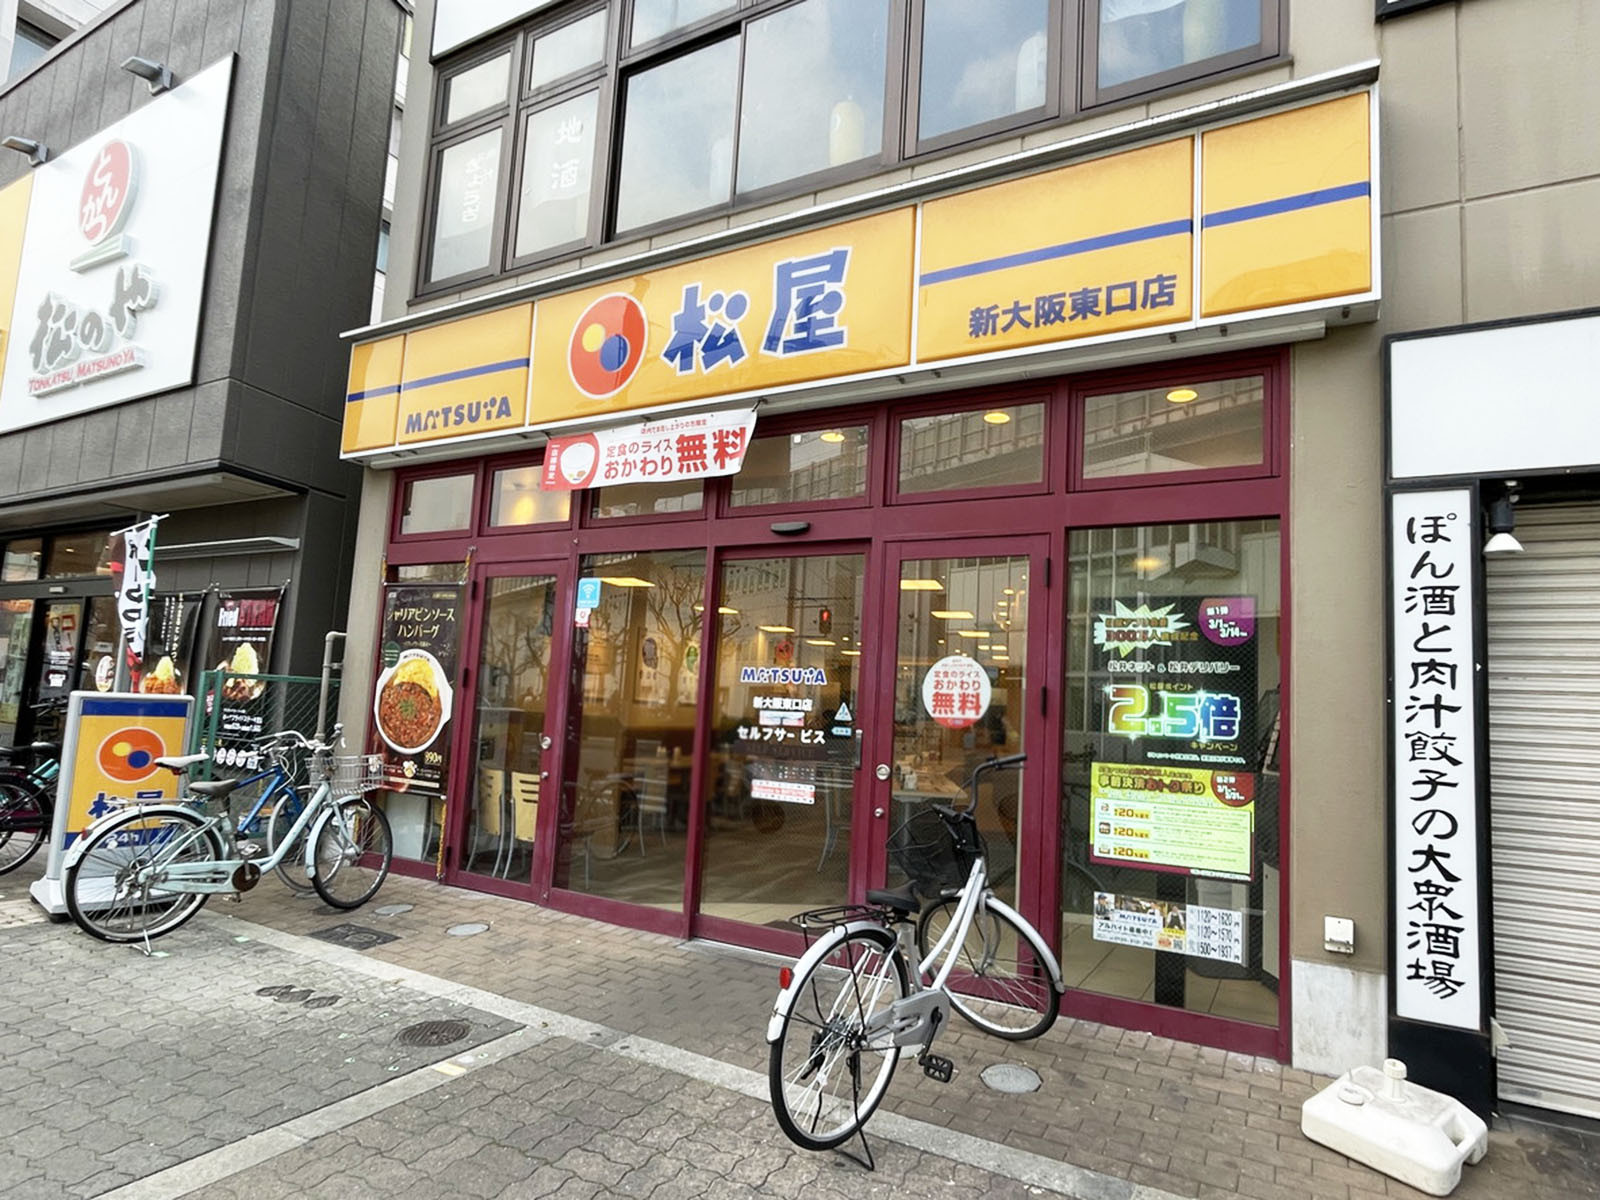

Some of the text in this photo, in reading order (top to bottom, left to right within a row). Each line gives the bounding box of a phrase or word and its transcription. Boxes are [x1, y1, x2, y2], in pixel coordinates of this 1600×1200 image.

[83, 150, 118, 241] とんかつ
[662, 246, 853, 376] 松屋
[968, 273, 1178, 338] 新大阪東口店
[29, 264, 150, 373] 松のや
[405, 396, 511, 434] MATSUYA
[606, 437, 673, 459] 定食のライス
[676, 426, 747, 474] 無料
[604, 455, 673, 480] おかわり
[397, 624, 440, 639] ハンバーグ
[741, 667, 827, 685] MATSUYA
[933, 680, 981, 690] おかわり
[753, 696, 813, 712] 新大阪東口店
[932, 692, 981, 716] 無料
[1109, 684, 1241, 740] 2.5倍
[737, 725, 826, 745] セルフサービス
